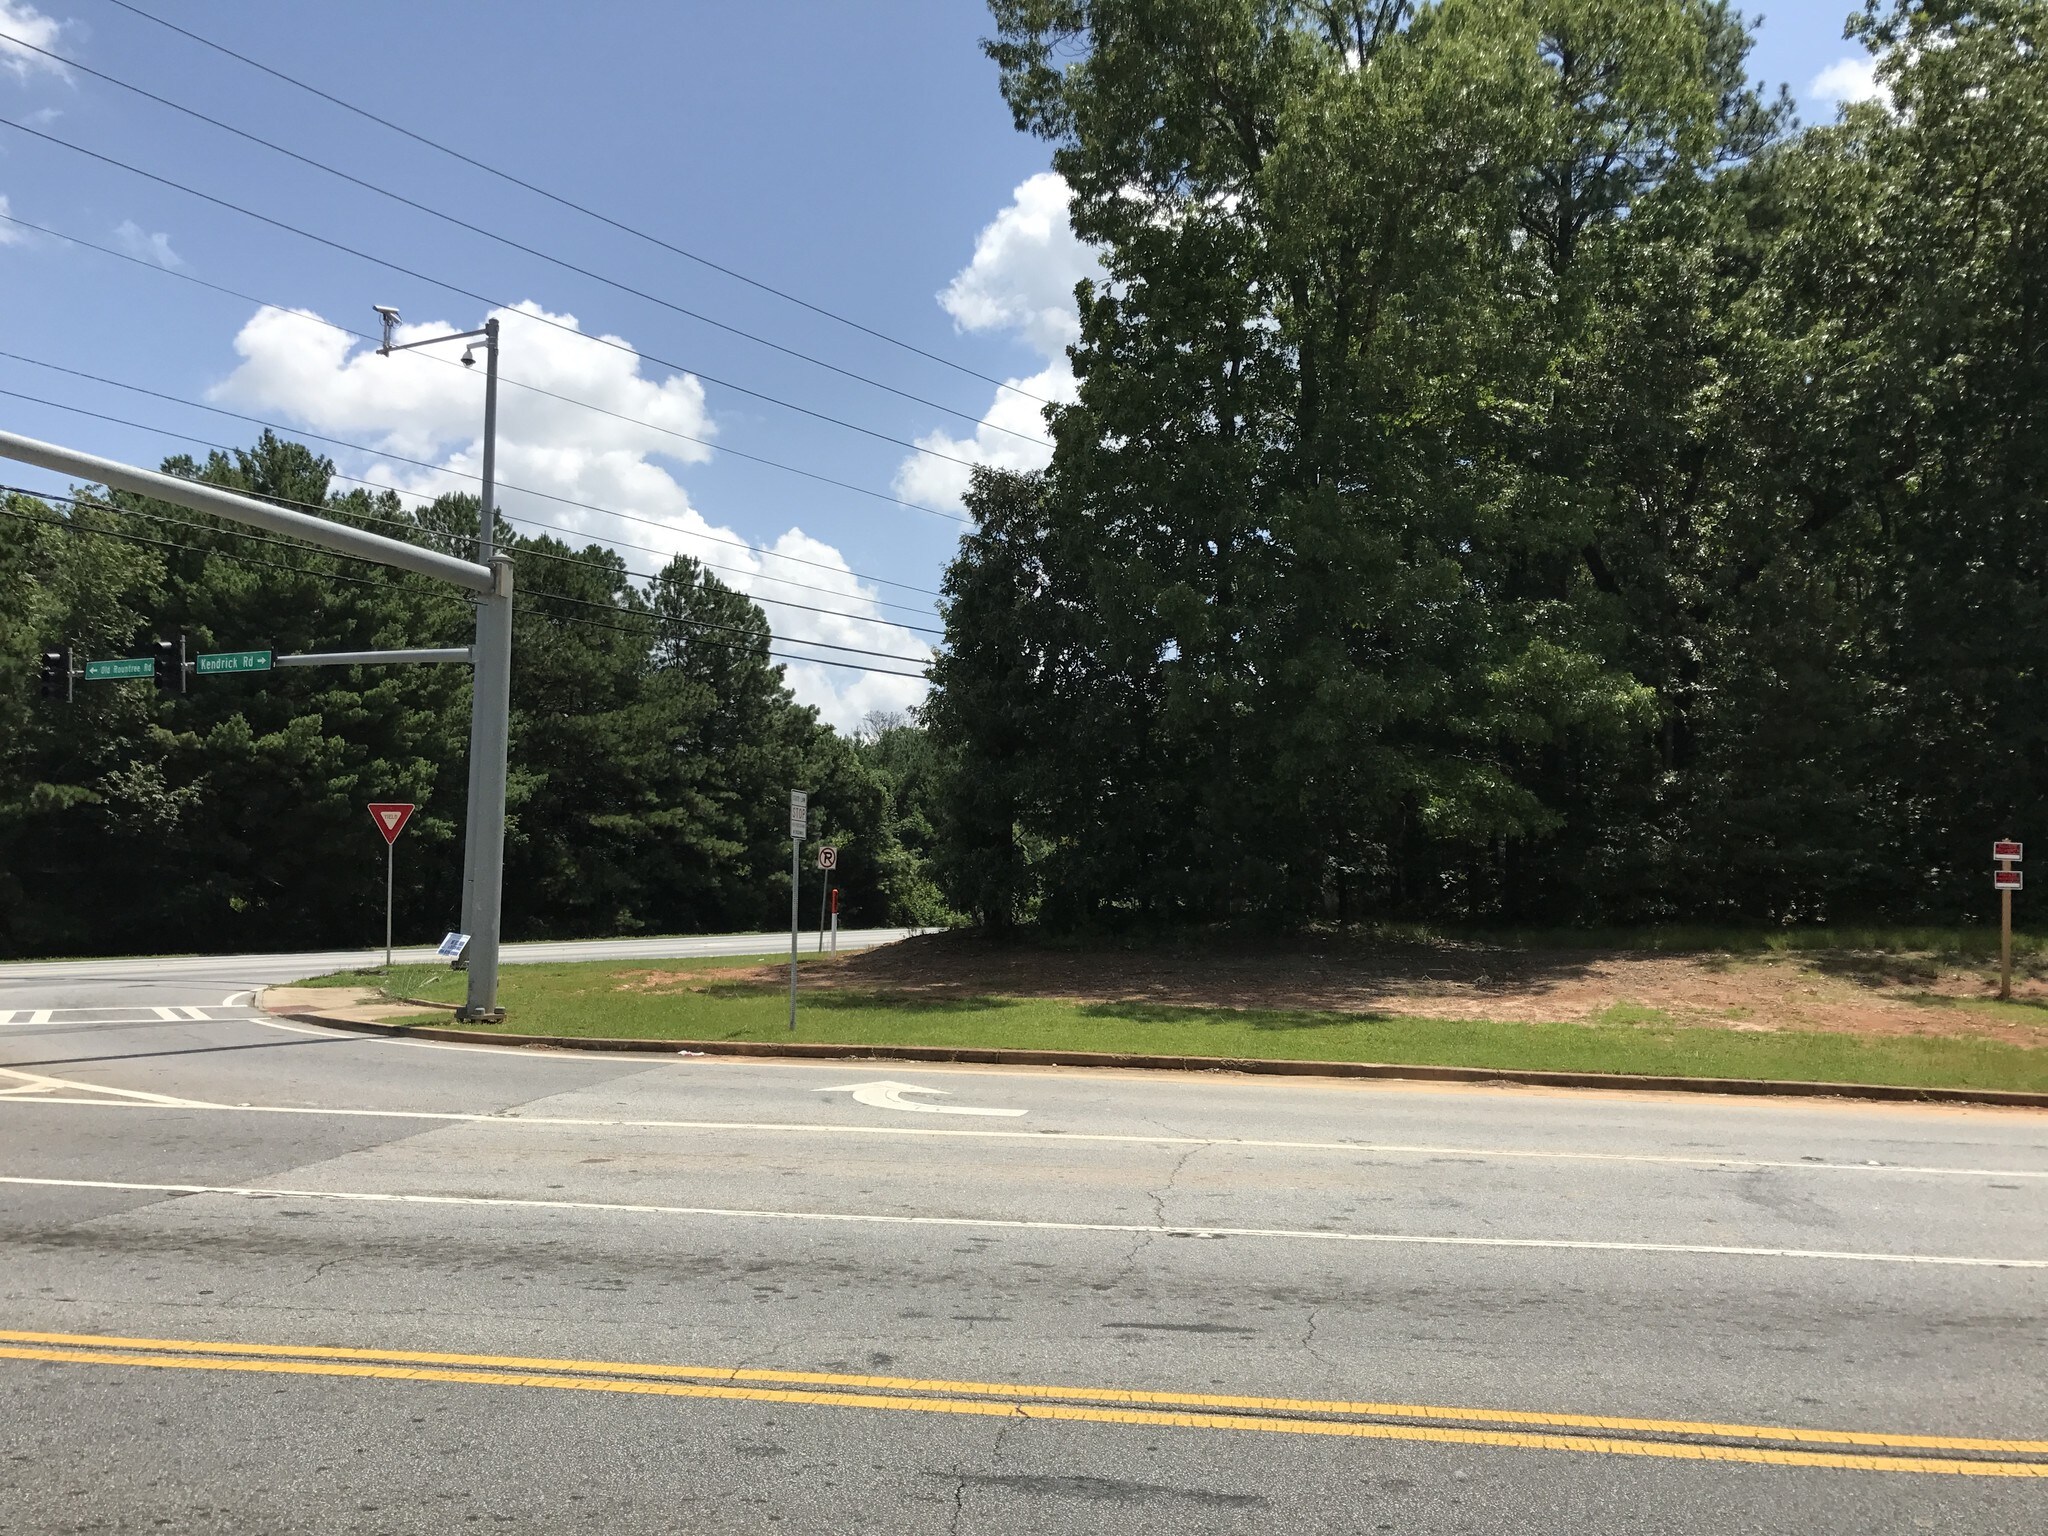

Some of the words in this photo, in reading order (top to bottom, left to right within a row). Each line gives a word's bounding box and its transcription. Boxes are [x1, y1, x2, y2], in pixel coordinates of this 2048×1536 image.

[100, 666, 111, 675] Old
[113, 664, 141, 674] Rountree
[143, 663, 152, 672] Rd
[201, 657, 238, 670] Kendrick
[242, 656, 254, 668] Rd
[793, 807, 805, 820] STOP
